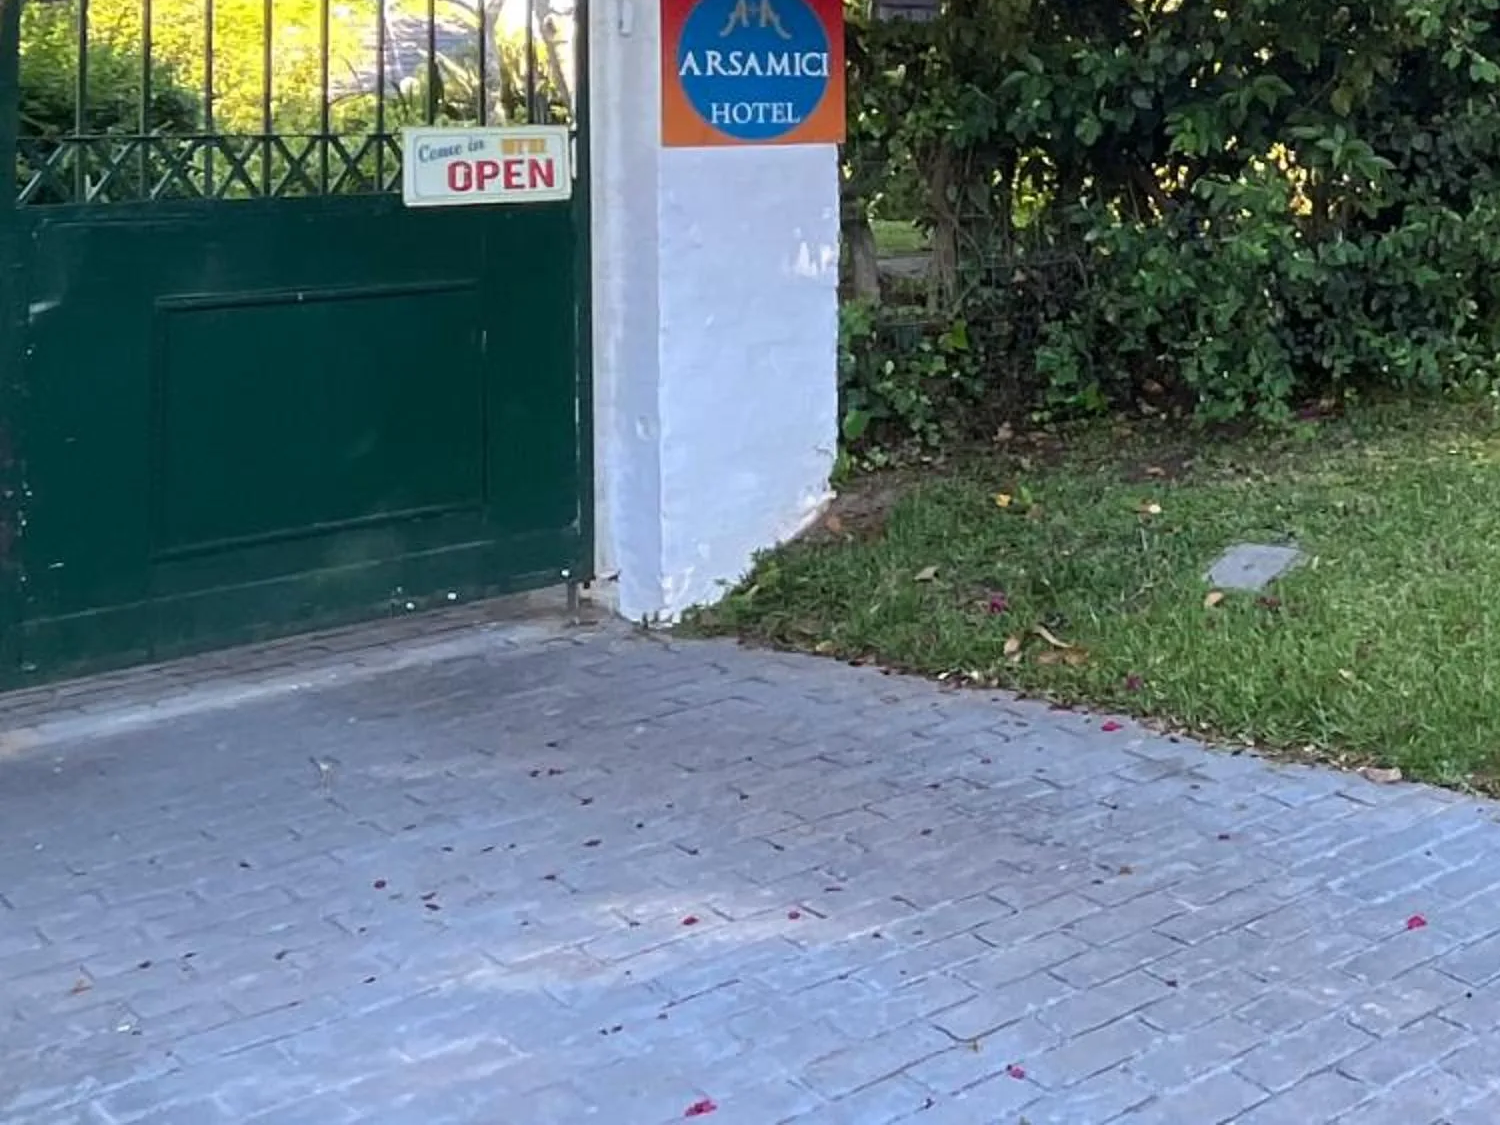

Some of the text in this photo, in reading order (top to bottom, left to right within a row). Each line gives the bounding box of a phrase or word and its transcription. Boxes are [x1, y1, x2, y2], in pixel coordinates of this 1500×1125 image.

[679, 50, 830, 77] ARSAMICI
[711, 102, 801, 124] HOTEL
[418, 143, 462, 163] Come
[468, 136, 485, 153] in
[447, 158, 555, 192] OPEN
